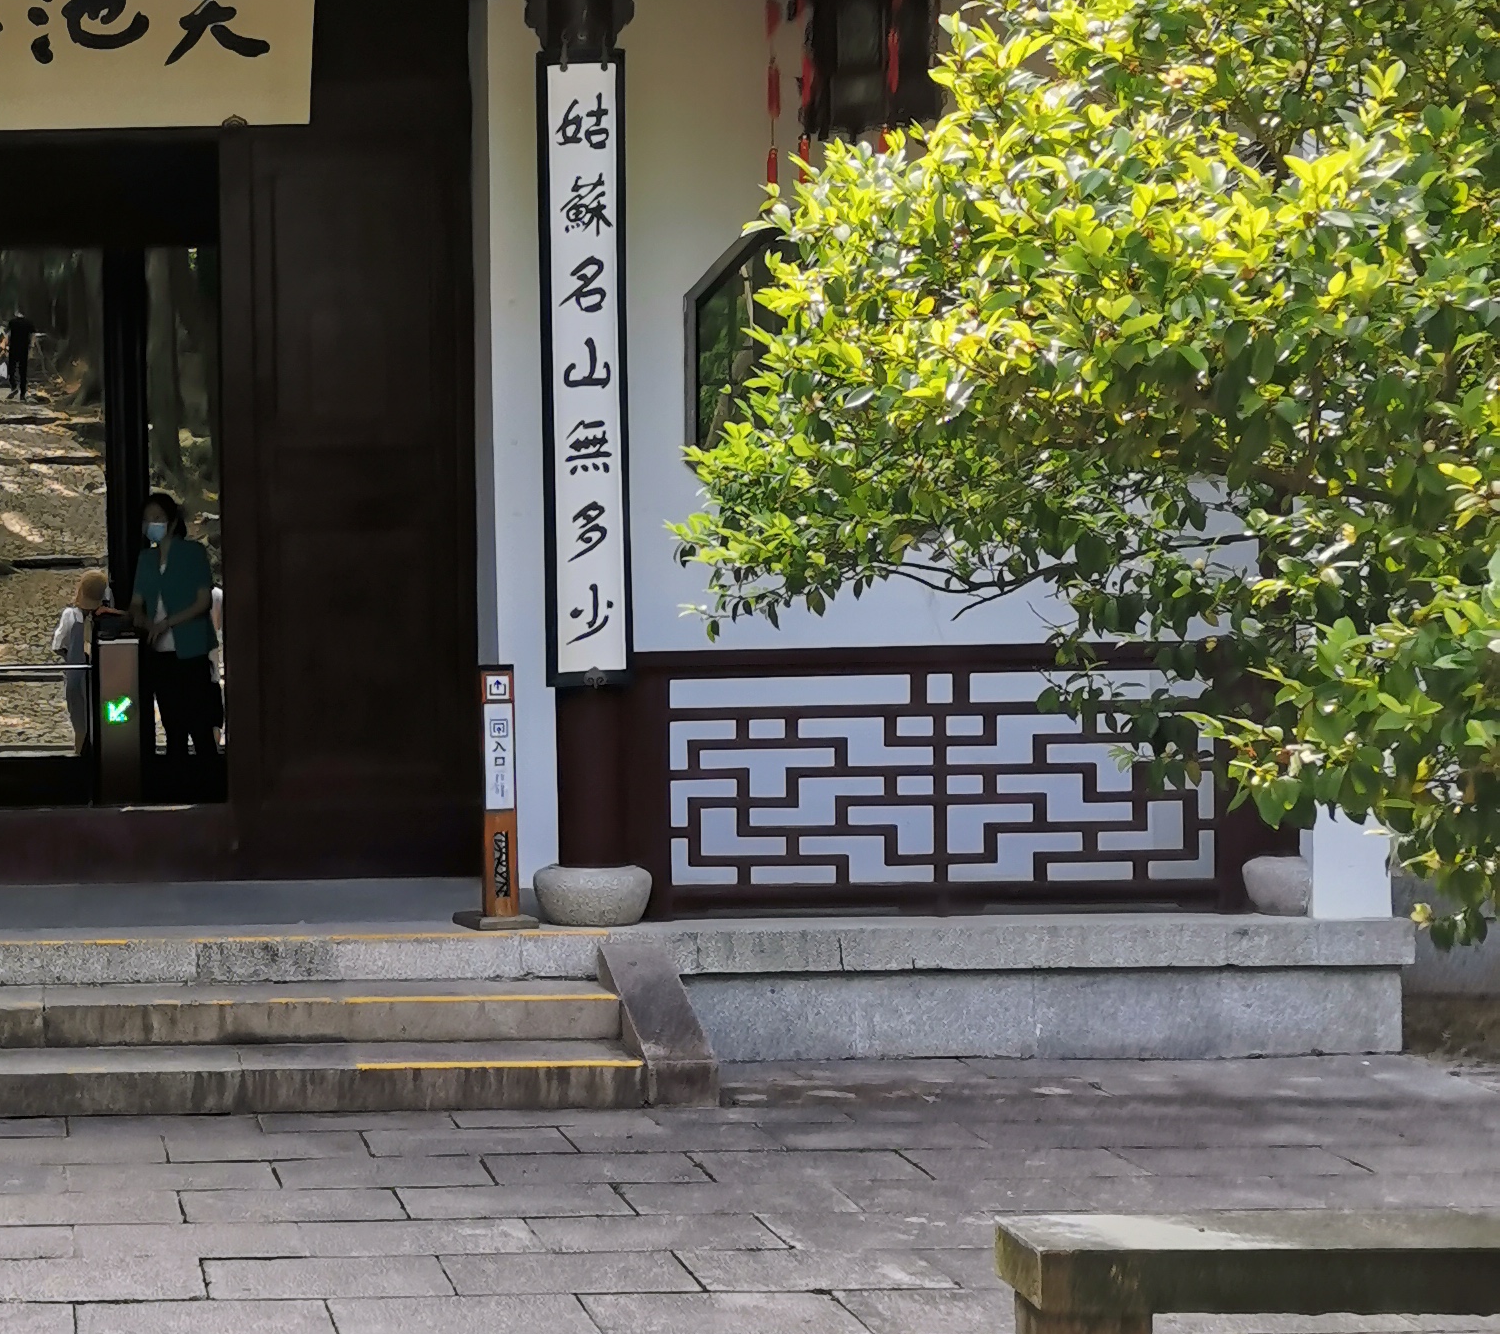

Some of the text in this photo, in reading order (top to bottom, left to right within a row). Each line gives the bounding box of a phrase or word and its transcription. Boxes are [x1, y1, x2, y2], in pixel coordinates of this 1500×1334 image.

[555, 92, 615, 646] 姑蘇名山無多少
[492, 740, 507, 767] 入口
